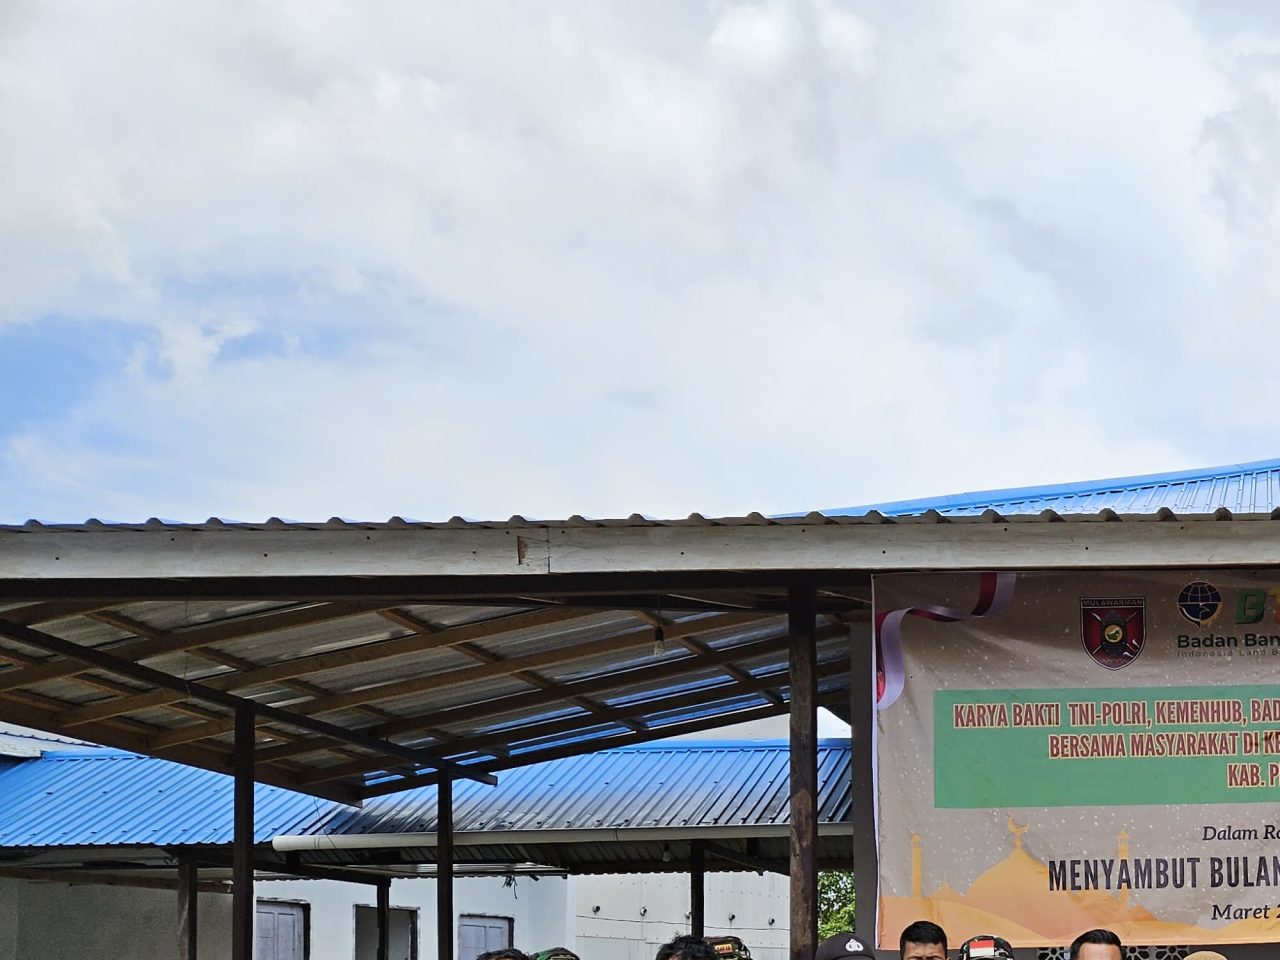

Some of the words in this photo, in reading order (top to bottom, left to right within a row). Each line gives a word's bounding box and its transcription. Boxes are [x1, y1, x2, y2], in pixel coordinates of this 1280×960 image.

[1177, 633, 1238, 648] Badan
[1177, 650, 1233, 658] Indonesia
[1239, 649, 1266, 657] Land
[954, 703, 1008, 728] KARYA
[1012, 701, 1060, 727] BAKTI
[1069, 701, 1152, 729] TNI-POLRI,
[1156, 699, 1248, 727] KEMENHUB,
[1049, 734, 1128, 759] BERSAMA
[1130, 731, 1240, 758] MASYARAKAT
[1243, 731, 1261, 756] DI
[1227, 762, 1266, 788] KAB.
[1202, 825, 1258, 842] Dalam
[1049, 857, 1200, 891] MENYAMBUT
[1211, 903, 1270, 921] Maret
